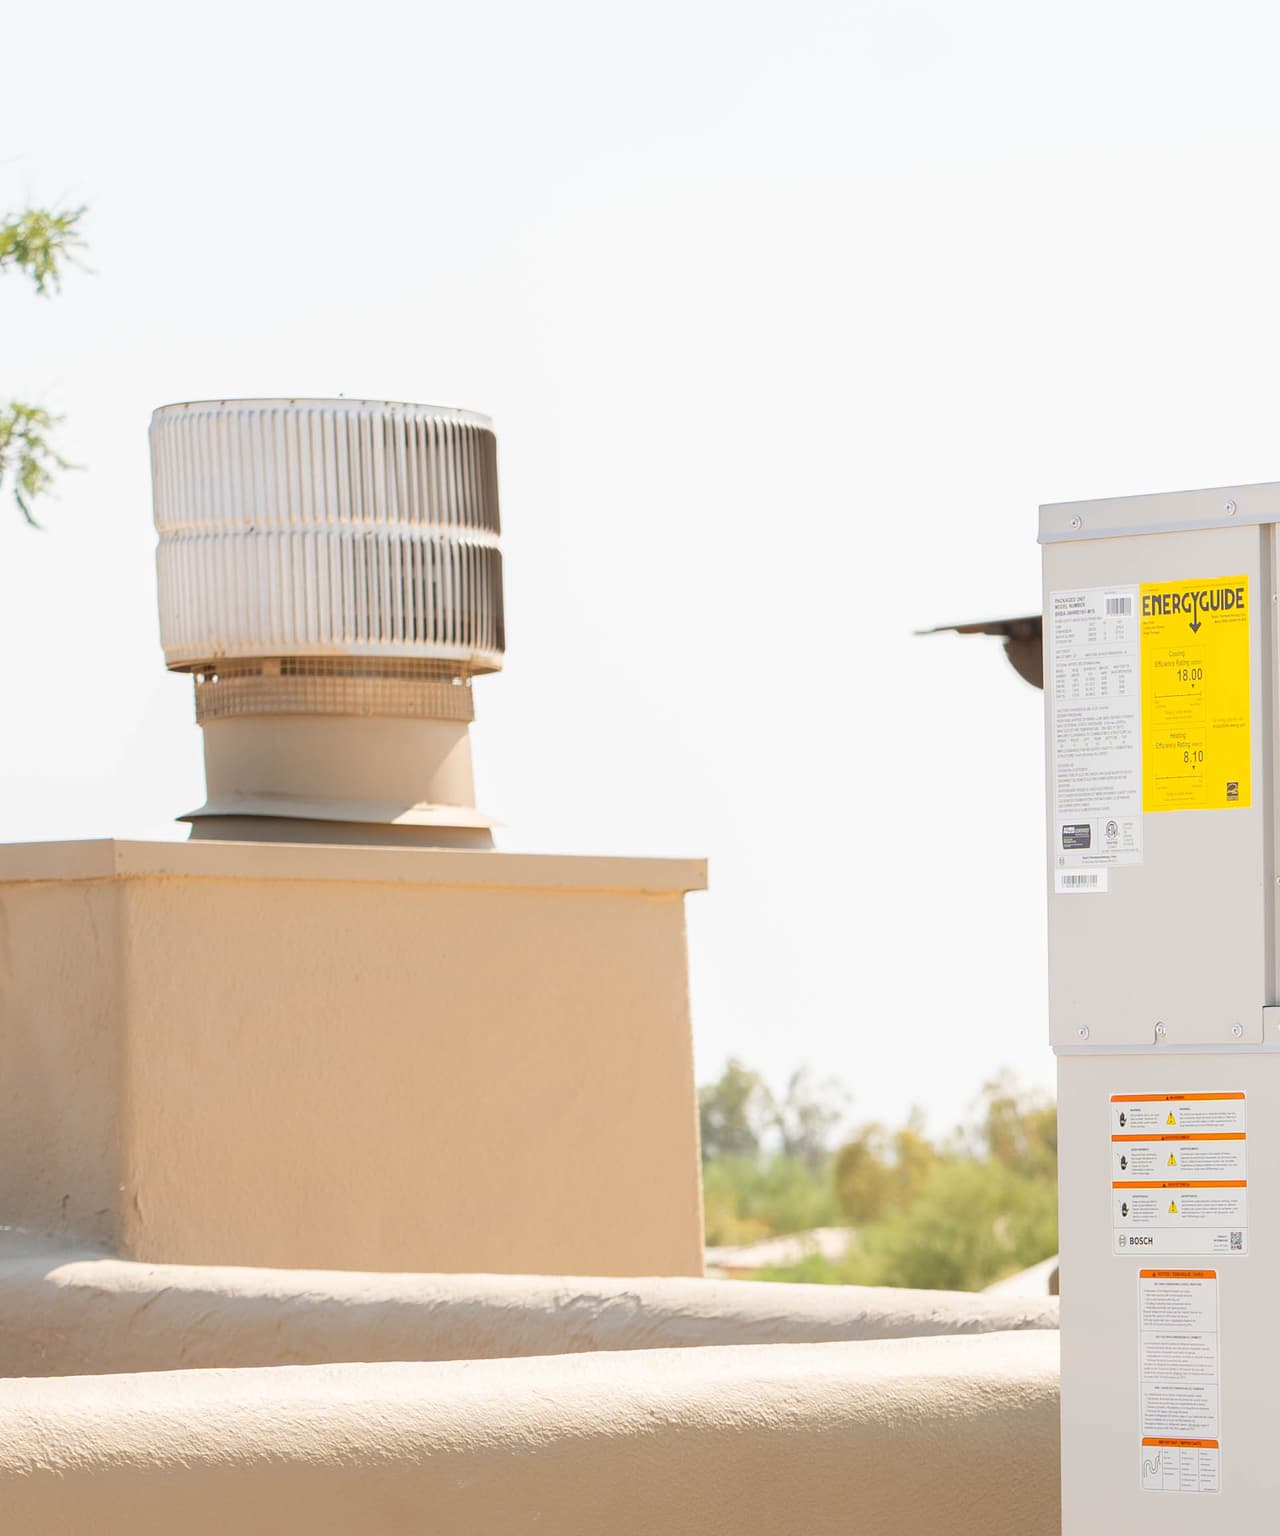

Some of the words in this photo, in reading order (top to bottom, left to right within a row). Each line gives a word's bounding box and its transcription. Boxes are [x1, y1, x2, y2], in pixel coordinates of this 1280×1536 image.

[1142, 587, 1245, 616] ENERGYGUIDE
[1177, 668, 1203, 681] 18.00
[1183, 750, 1204, 763] 8.10
[1129, 1237, 1153, 1245] BOSCH
